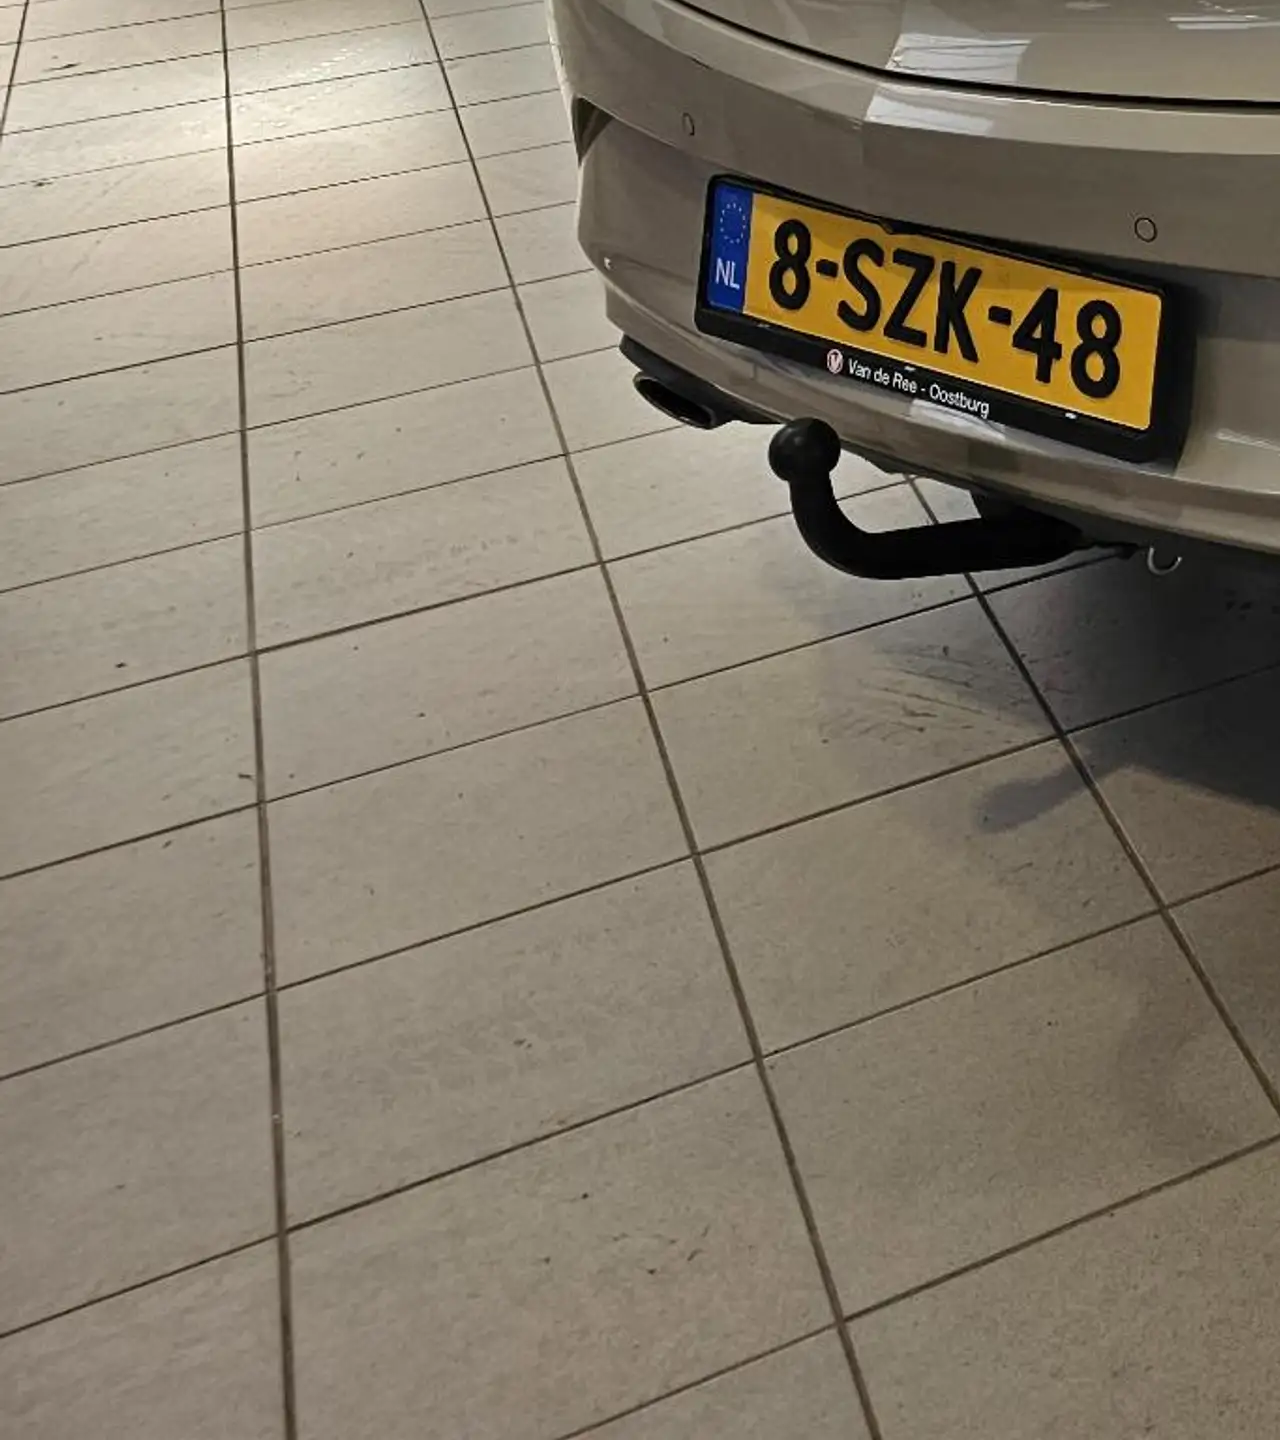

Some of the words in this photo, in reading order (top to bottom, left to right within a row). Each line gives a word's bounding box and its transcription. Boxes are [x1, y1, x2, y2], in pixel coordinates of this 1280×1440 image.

[715, 257, 740, 289] NL
[768, 218, 1122, 400] 8-SZK-48
[848, 358, 871, 380] Van
[873, 367, 890, 386] de
[892, 371, 918, 394] Ree
[929, 383, 990, 419] Oostburg
